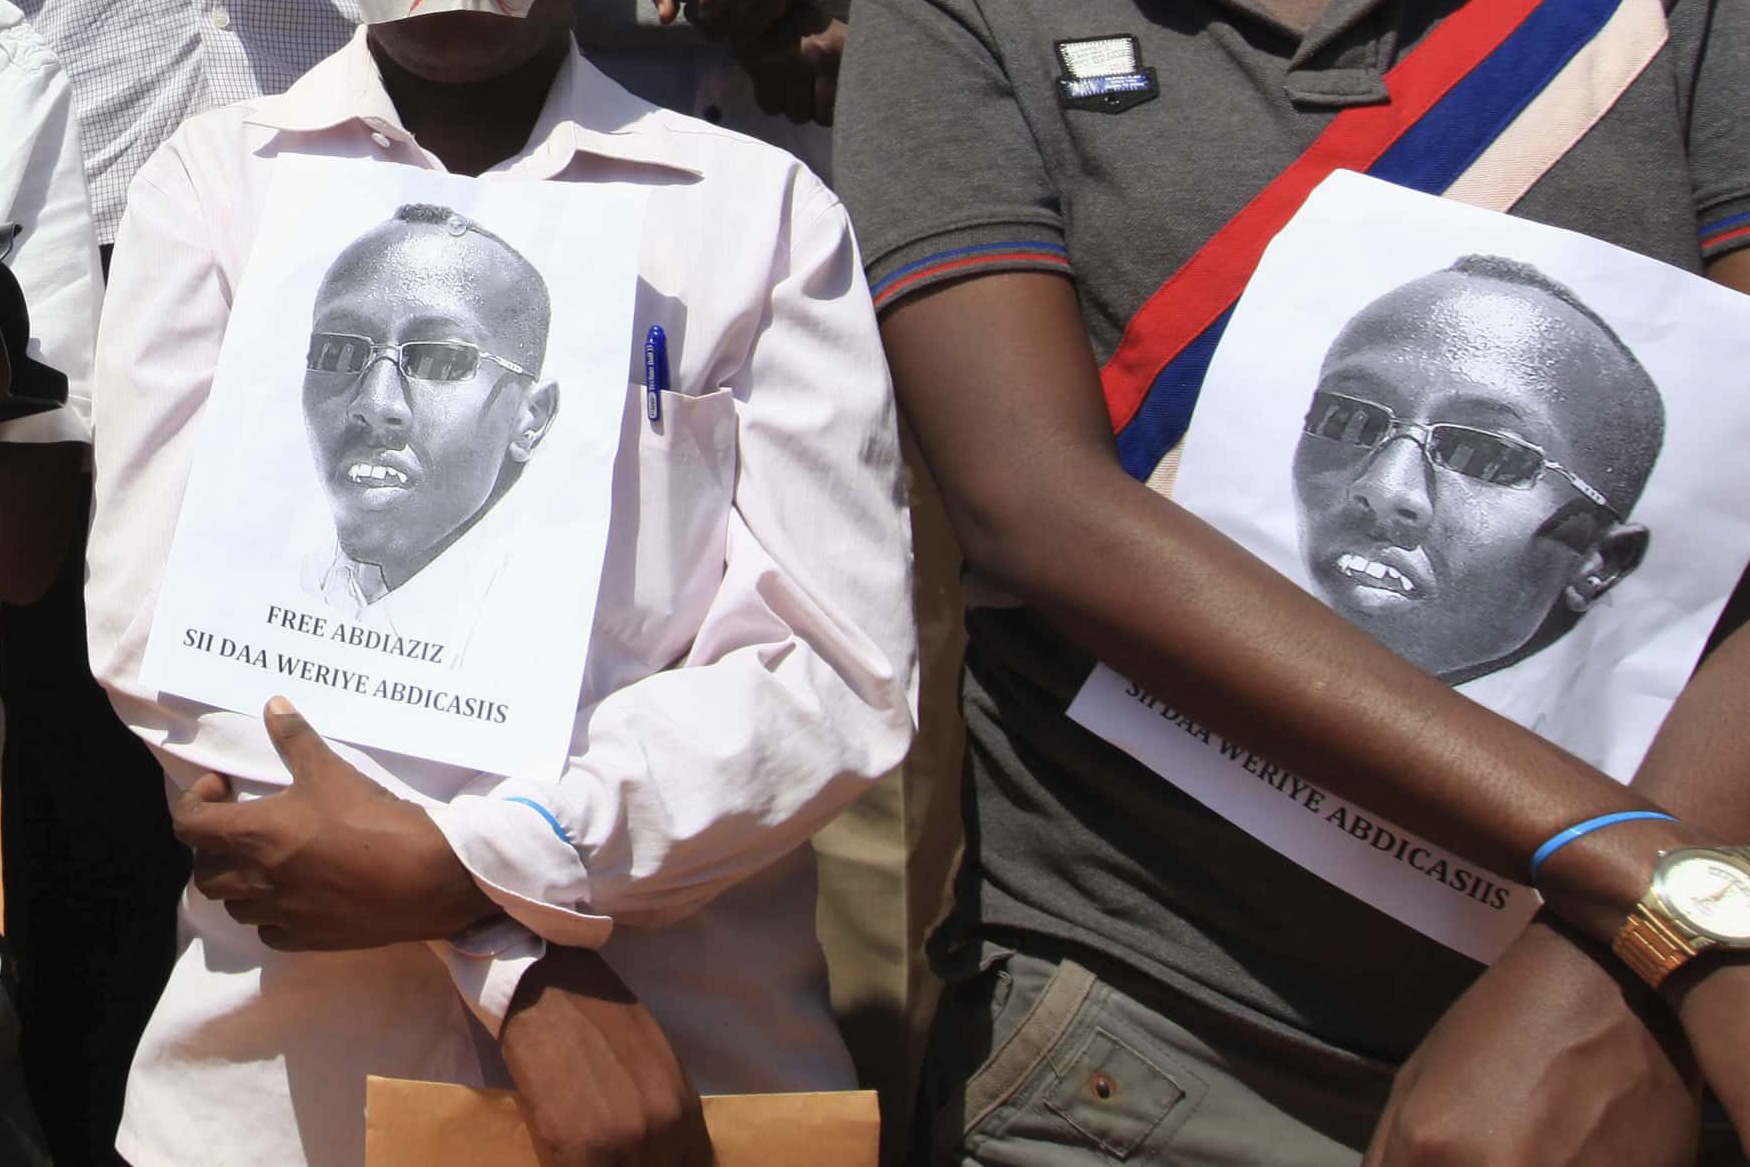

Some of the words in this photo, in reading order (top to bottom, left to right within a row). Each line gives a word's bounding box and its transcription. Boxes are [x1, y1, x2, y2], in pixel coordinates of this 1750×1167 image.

[183, 627, 214, 654] SII
[219, 637, 269, 670] DAA
[276, 651, 370, 696] WERIYE
[372, 679, 509, 725] ABDICASIIS
[266, 604, 328, 639] FREE
[330, 621, 445, 666] ABDIAZIZ
[1159, 704, 1211, 746] DAA
[1218, 738, 1326, 813] WERIYE
[1324, 805, 1511, 911] ABDICASIIS
